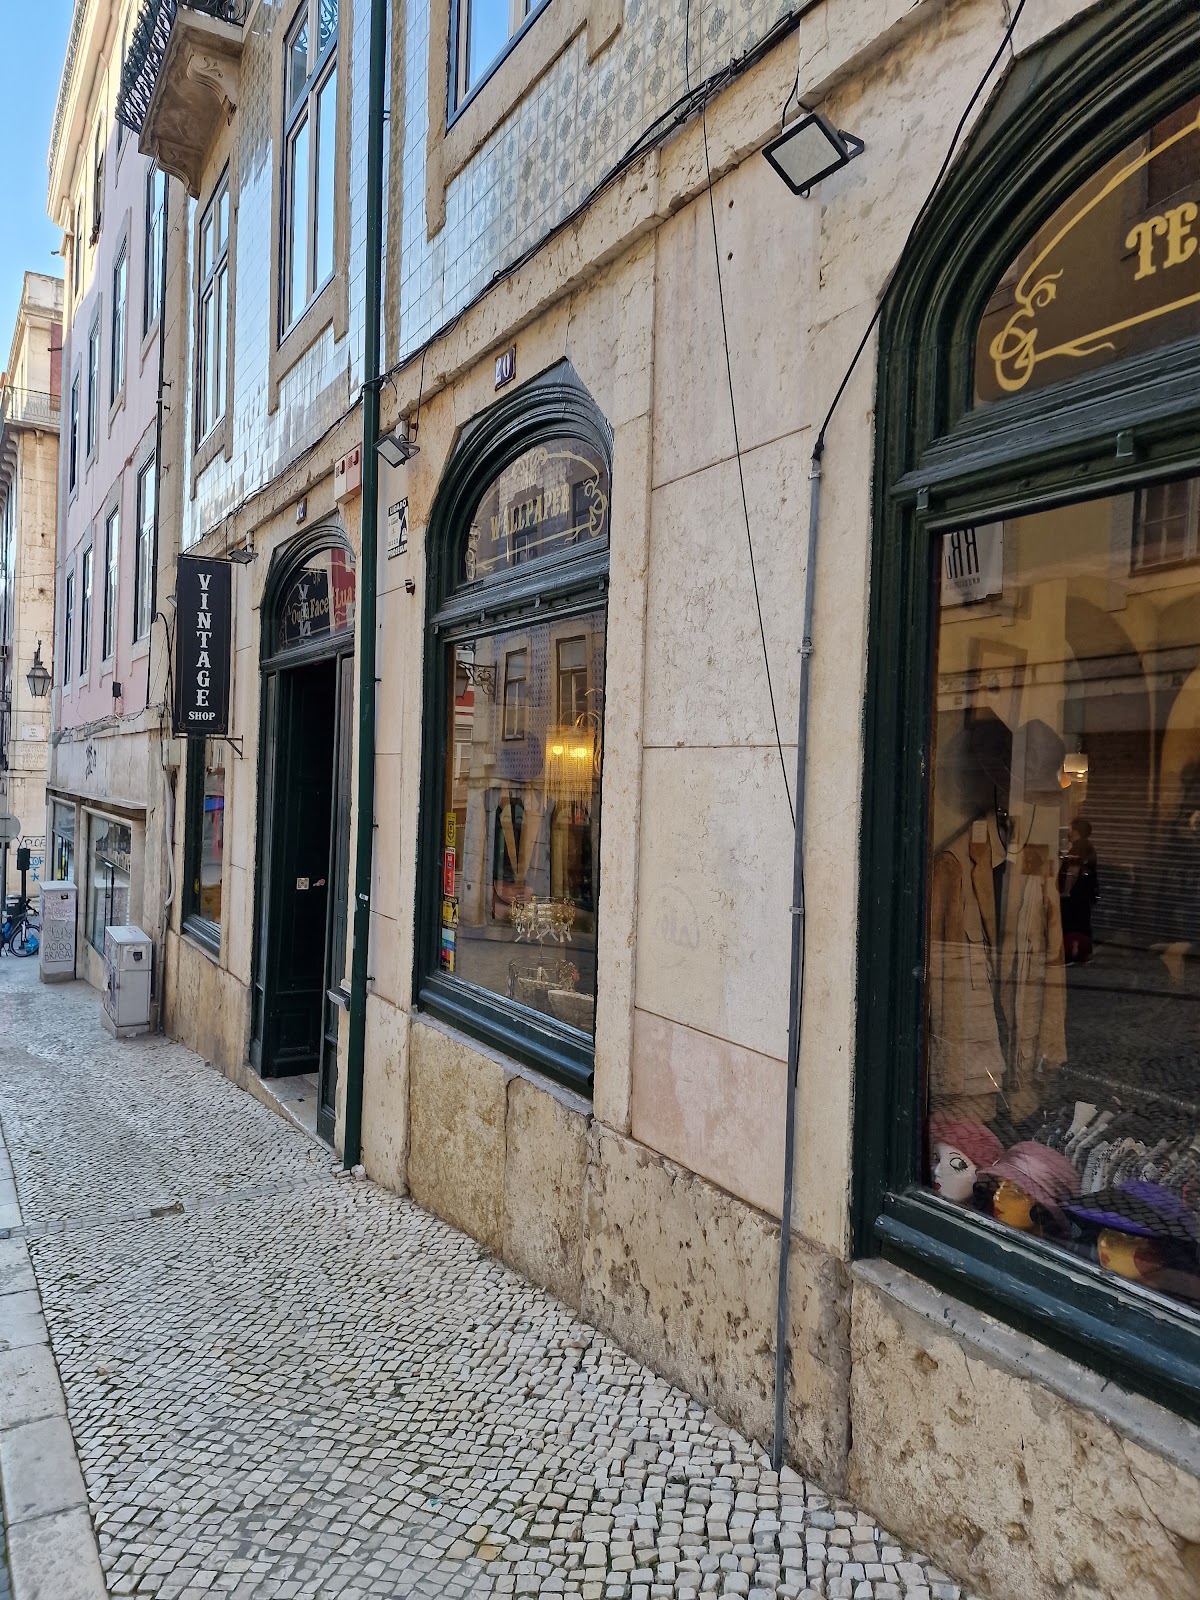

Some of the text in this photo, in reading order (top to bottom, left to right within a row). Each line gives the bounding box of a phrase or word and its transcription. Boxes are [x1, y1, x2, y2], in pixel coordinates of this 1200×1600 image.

[1125, 201, 1200, 281] TE
[496, 353, 510, 385] 20
[490, 483, 571, 542] WALLPAPER
[309, 596, 330, 619] Face
[334, 586, 353, 609] Lua
[195, 573, 212, 707] VINTAGE
[188, 711, 216, 721] SHOP
